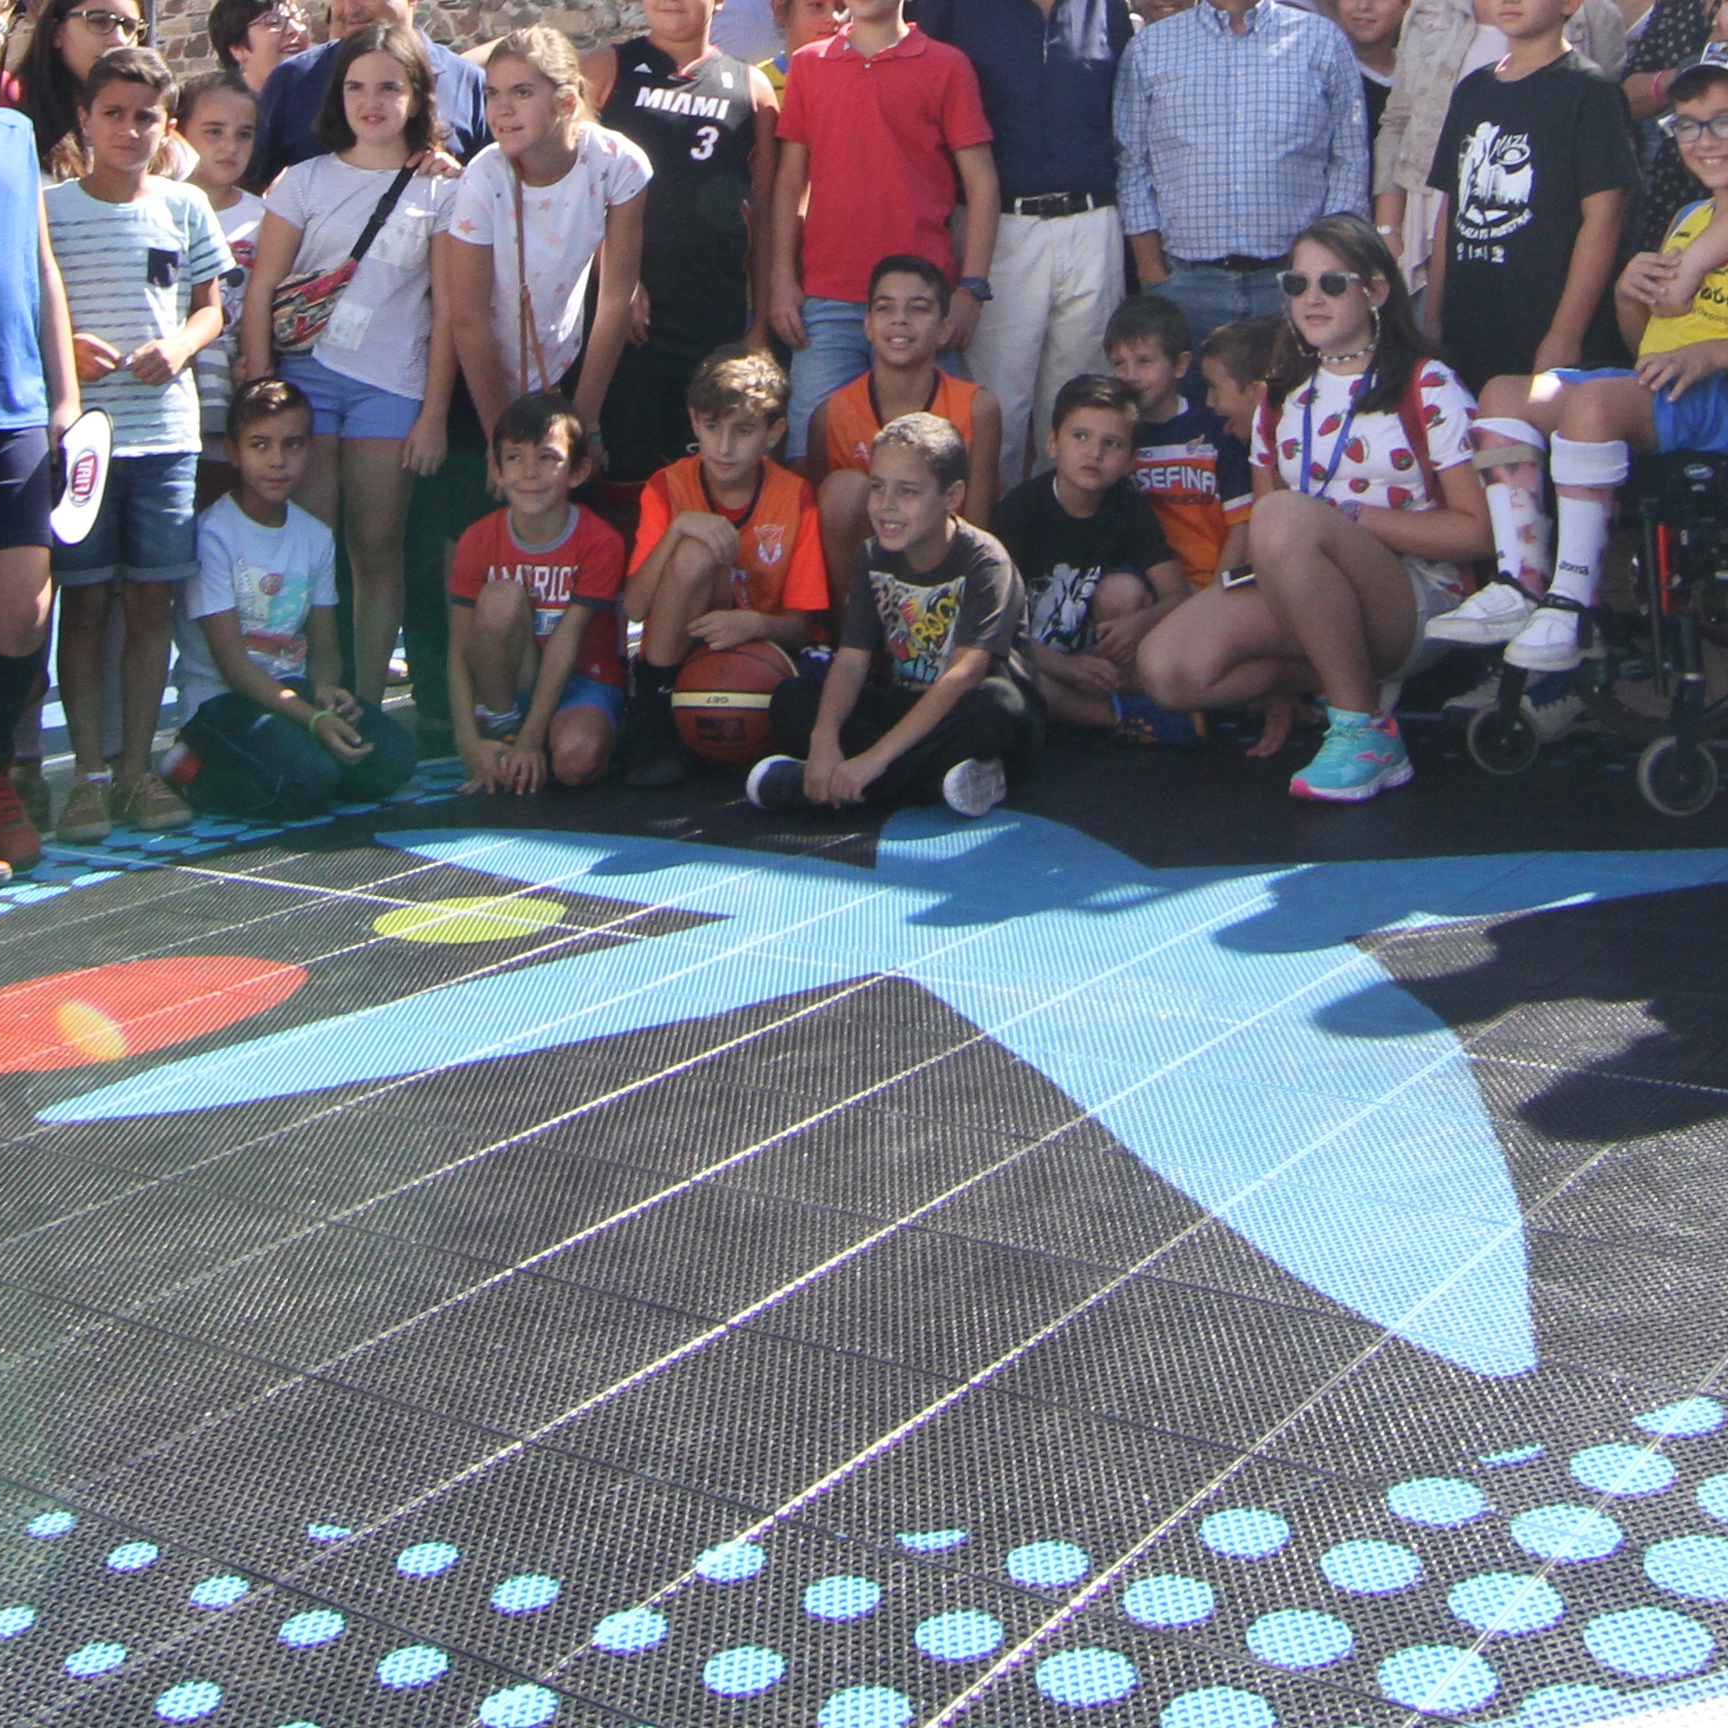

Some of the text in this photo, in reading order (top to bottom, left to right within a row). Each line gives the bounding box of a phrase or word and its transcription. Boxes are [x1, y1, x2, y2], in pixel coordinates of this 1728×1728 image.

[634, 86, 731, 121] MIAMI
[690, 125, 720, 161] 3
[1130, 465, 1217, 496] SEFINA
